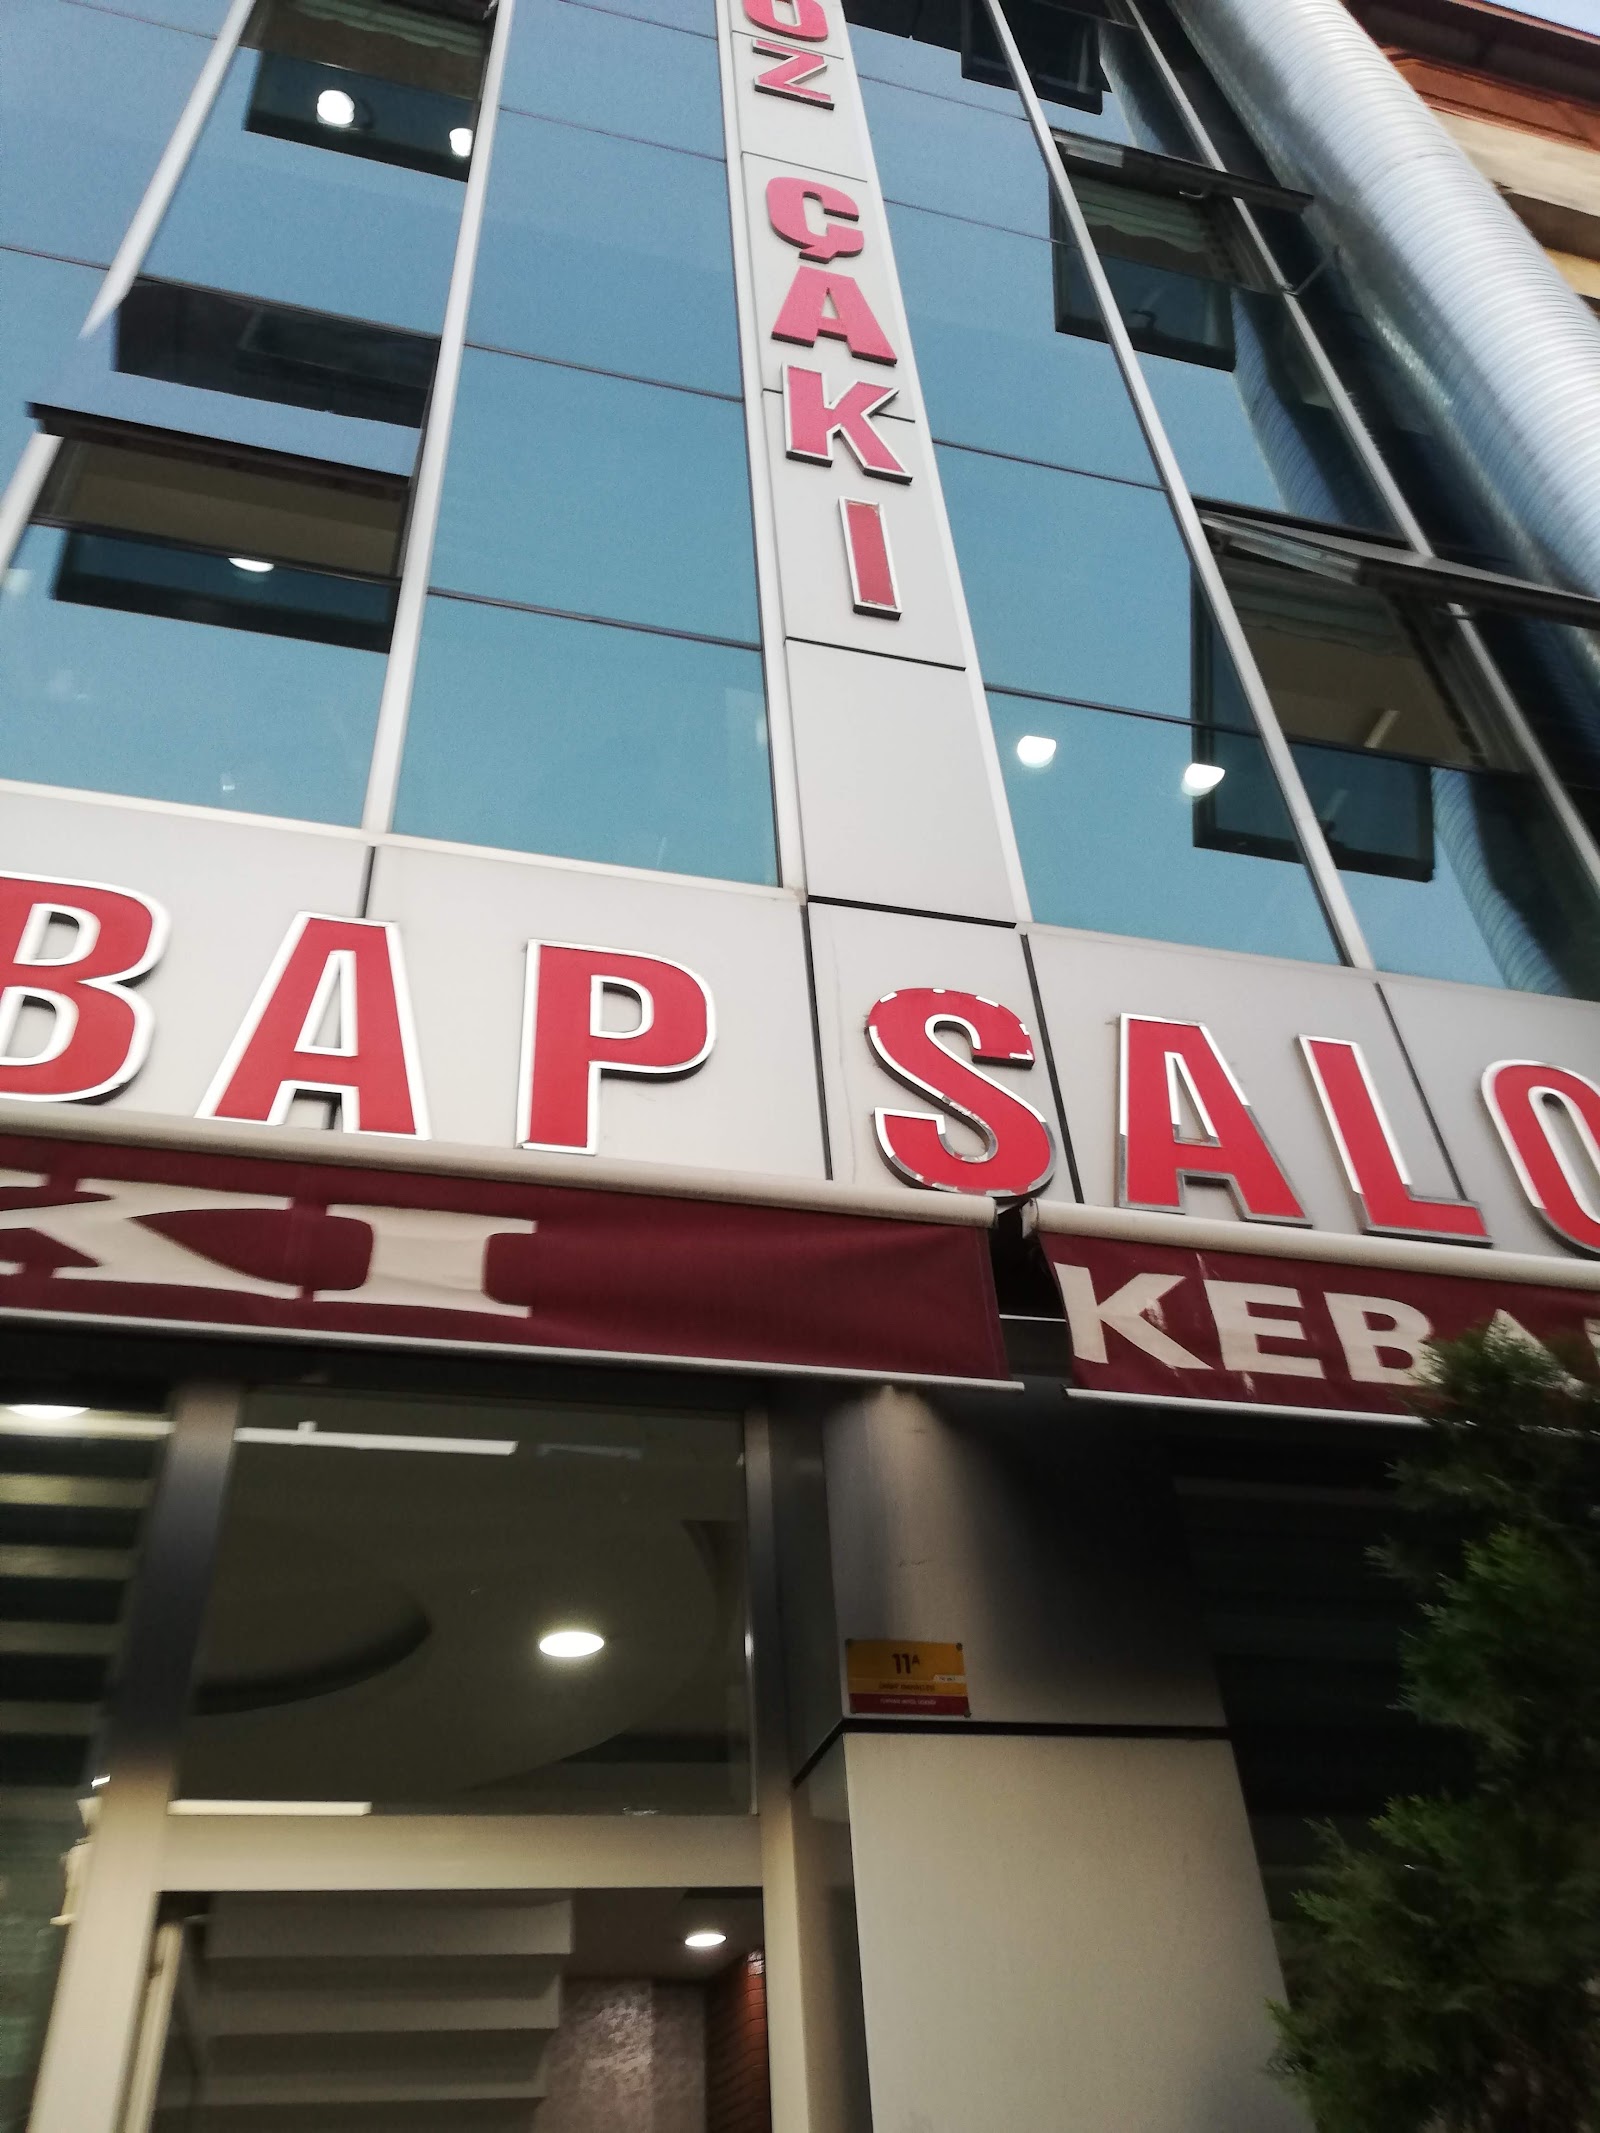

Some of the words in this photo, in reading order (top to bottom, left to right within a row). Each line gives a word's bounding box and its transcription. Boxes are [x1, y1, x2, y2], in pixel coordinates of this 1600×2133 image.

[765, 177, 913, 620] ÇAKI
[0, 871, 716, 1155] BAP
[866, 987, 1600, 1261] SALO
[1053, 1261, 1600, 1395] KEBA
